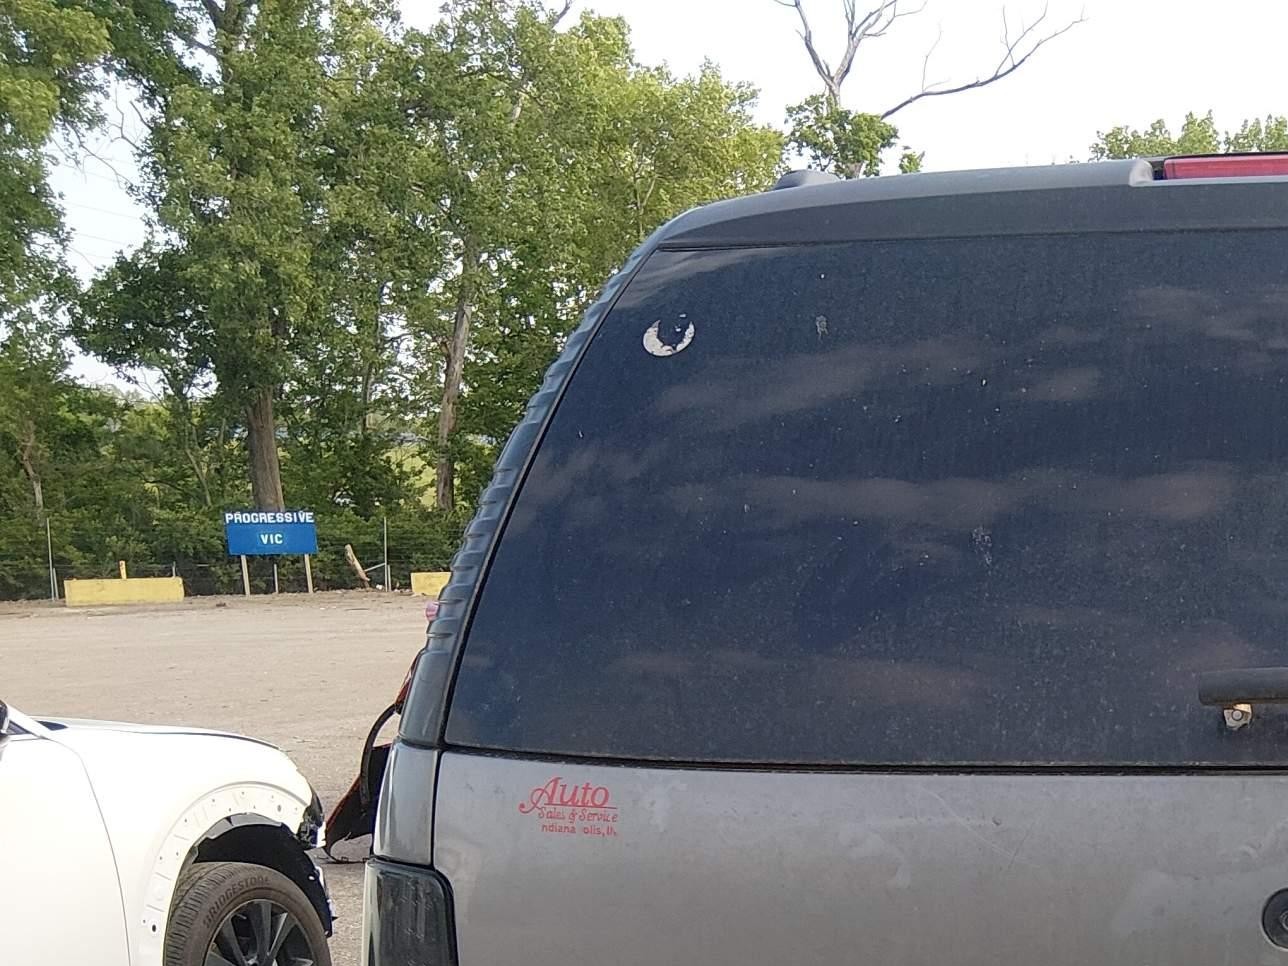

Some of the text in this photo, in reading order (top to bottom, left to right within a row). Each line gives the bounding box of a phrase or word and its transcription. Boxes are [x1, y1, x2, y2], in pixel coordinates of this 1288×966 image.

[225, 510, 315, 524] PROGRESSIVE
[260, 533, 283, 545] VIC
[518, 777, 610, 814] Auto
[579, 808, 618, 823] Service
